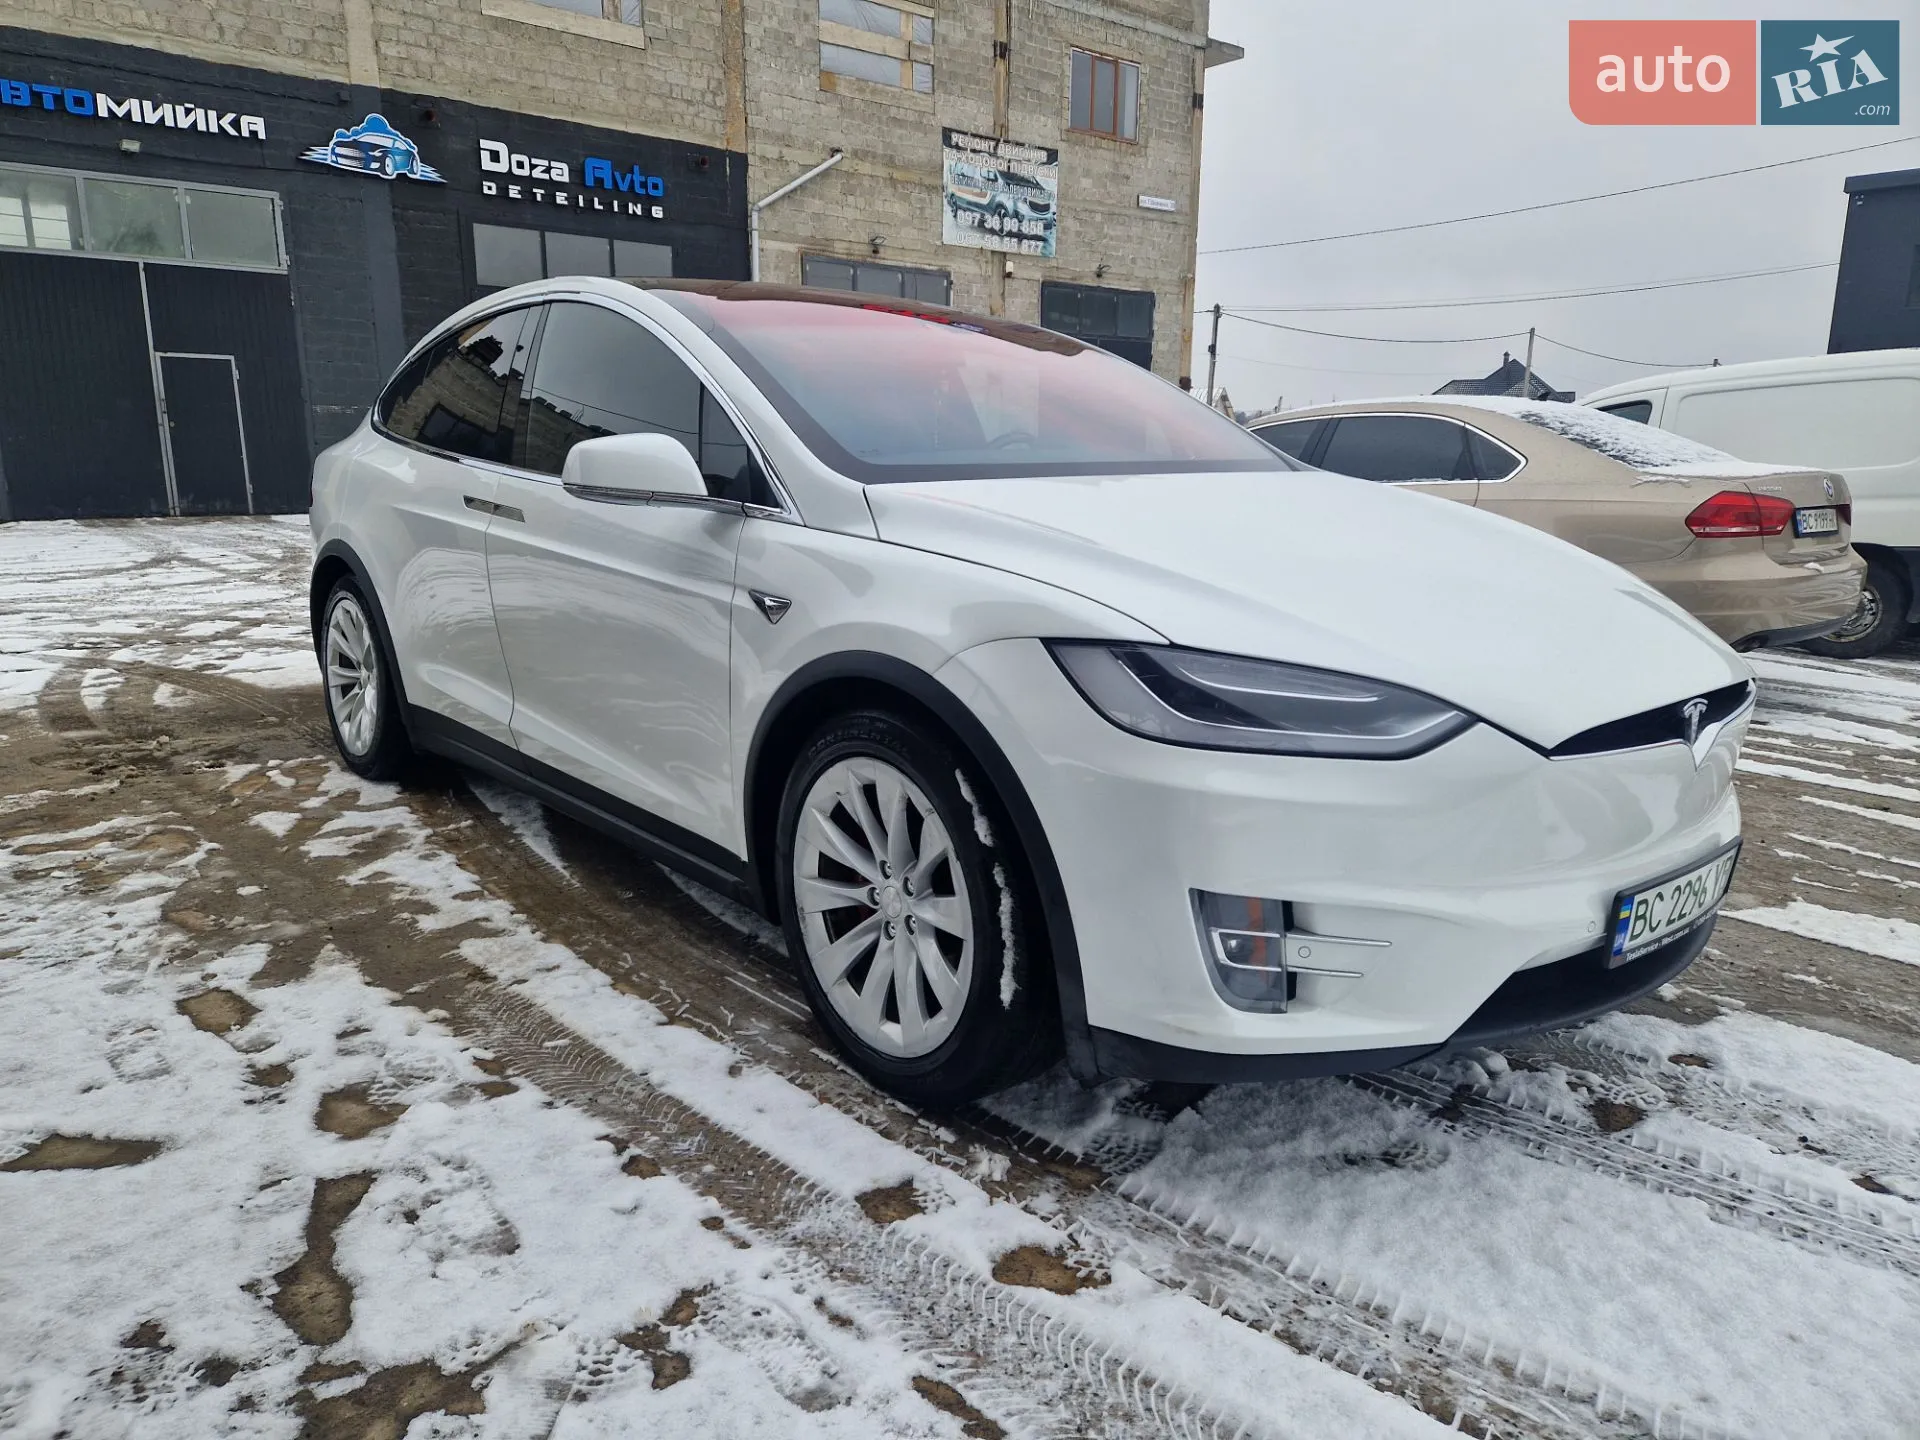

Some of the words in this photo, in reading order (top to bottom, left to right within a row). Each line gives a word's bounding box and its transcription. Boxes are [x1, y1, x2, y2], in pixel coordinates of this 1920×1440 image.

[479, 138, 570, 183] Doza
[584, 156, 664, 197] Avto
[482, 180, 664, 219] DETEILING
[1801, 513, 1813, 530] BC
[1629, 892, 1664, 941] BC
[1665, 868, 1712, 927] 2296
